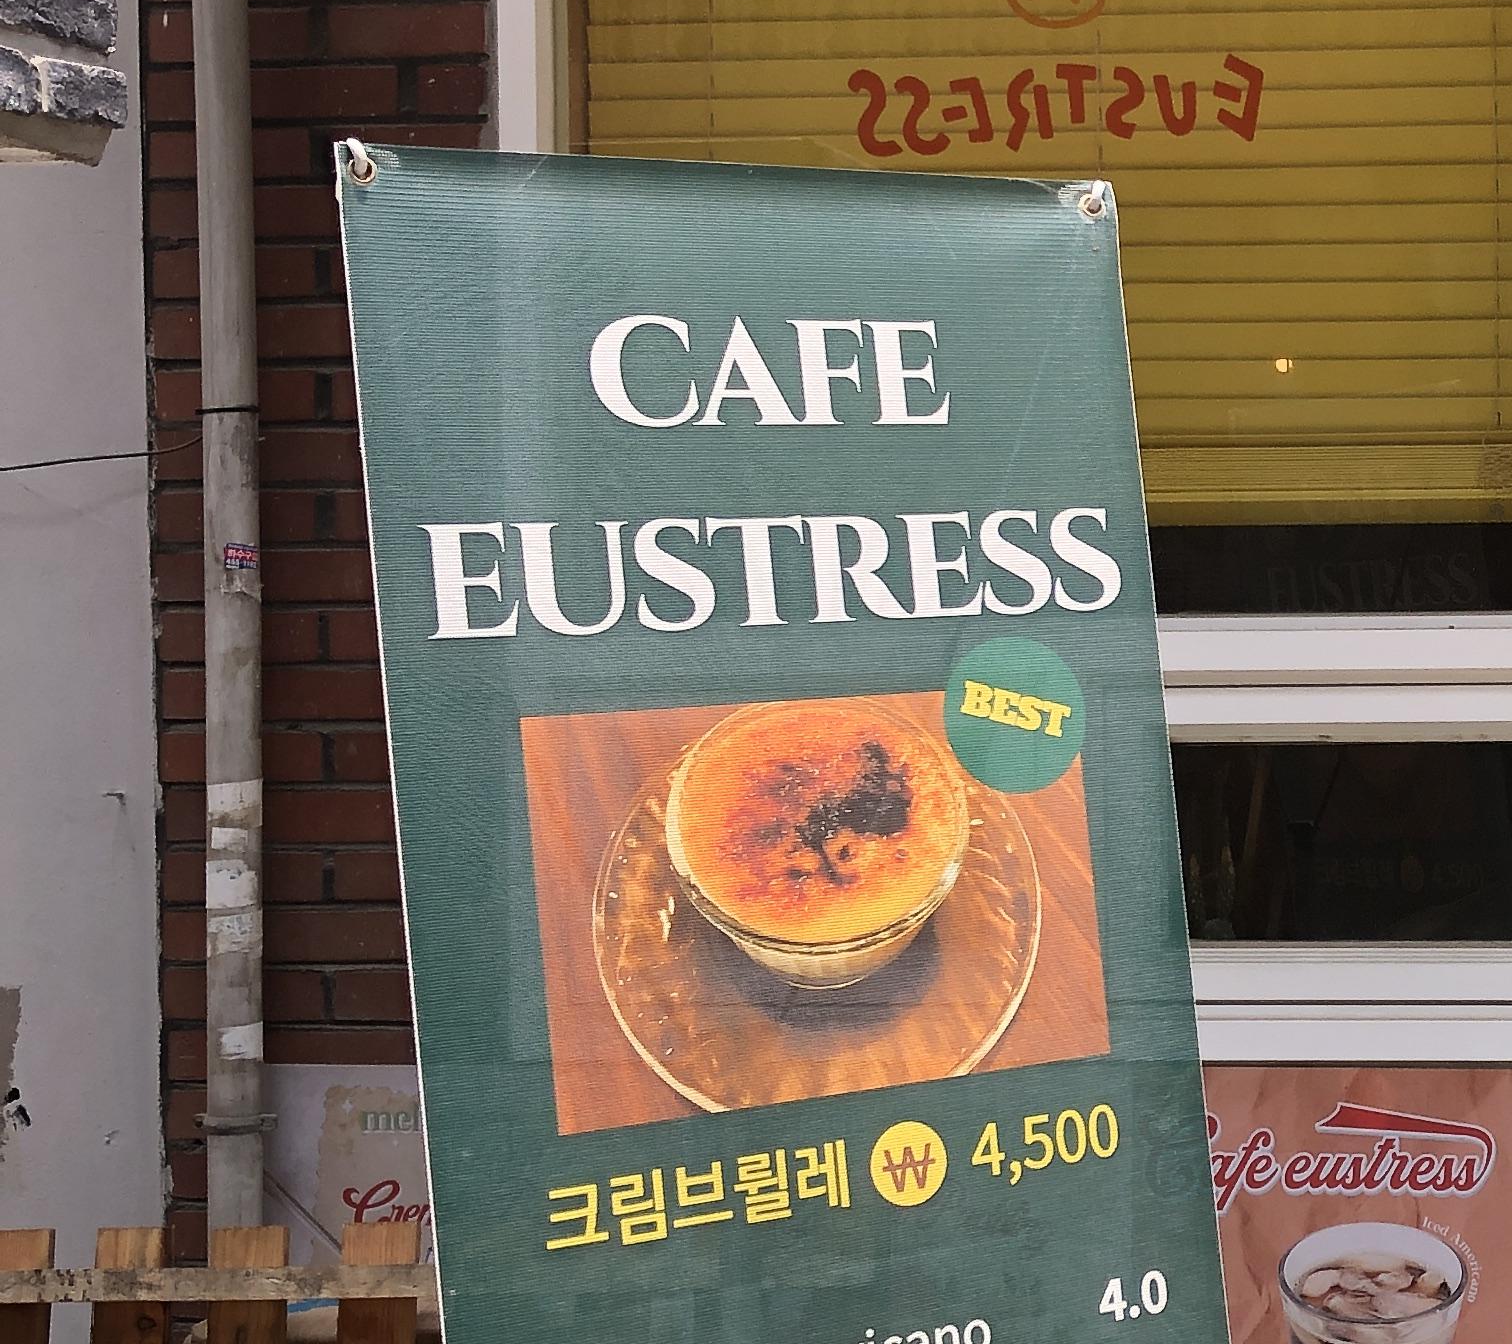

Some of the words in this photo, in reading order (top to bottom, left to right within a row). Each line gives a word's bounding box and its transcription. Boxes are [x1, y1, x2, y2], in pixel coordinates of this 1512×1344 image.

[590, 313, 951, 429] CAFE
[418, 507, 1124, 641] EUSTRESS
[961, 681, 1072, 738] BEST
[362, 1111, 420, 1132] mel
[1207, 1114, 1281, 1212] afe
[1283, 1102, 1497, 1198] eustress
[545, 1140, 851, 1252] 크림브륄레
[970, 1103, 1120, 1187] 4,500
[1422, 1216, 1450, 1237] Iced
[1098, 1269, 1169, 1324] 4.0
